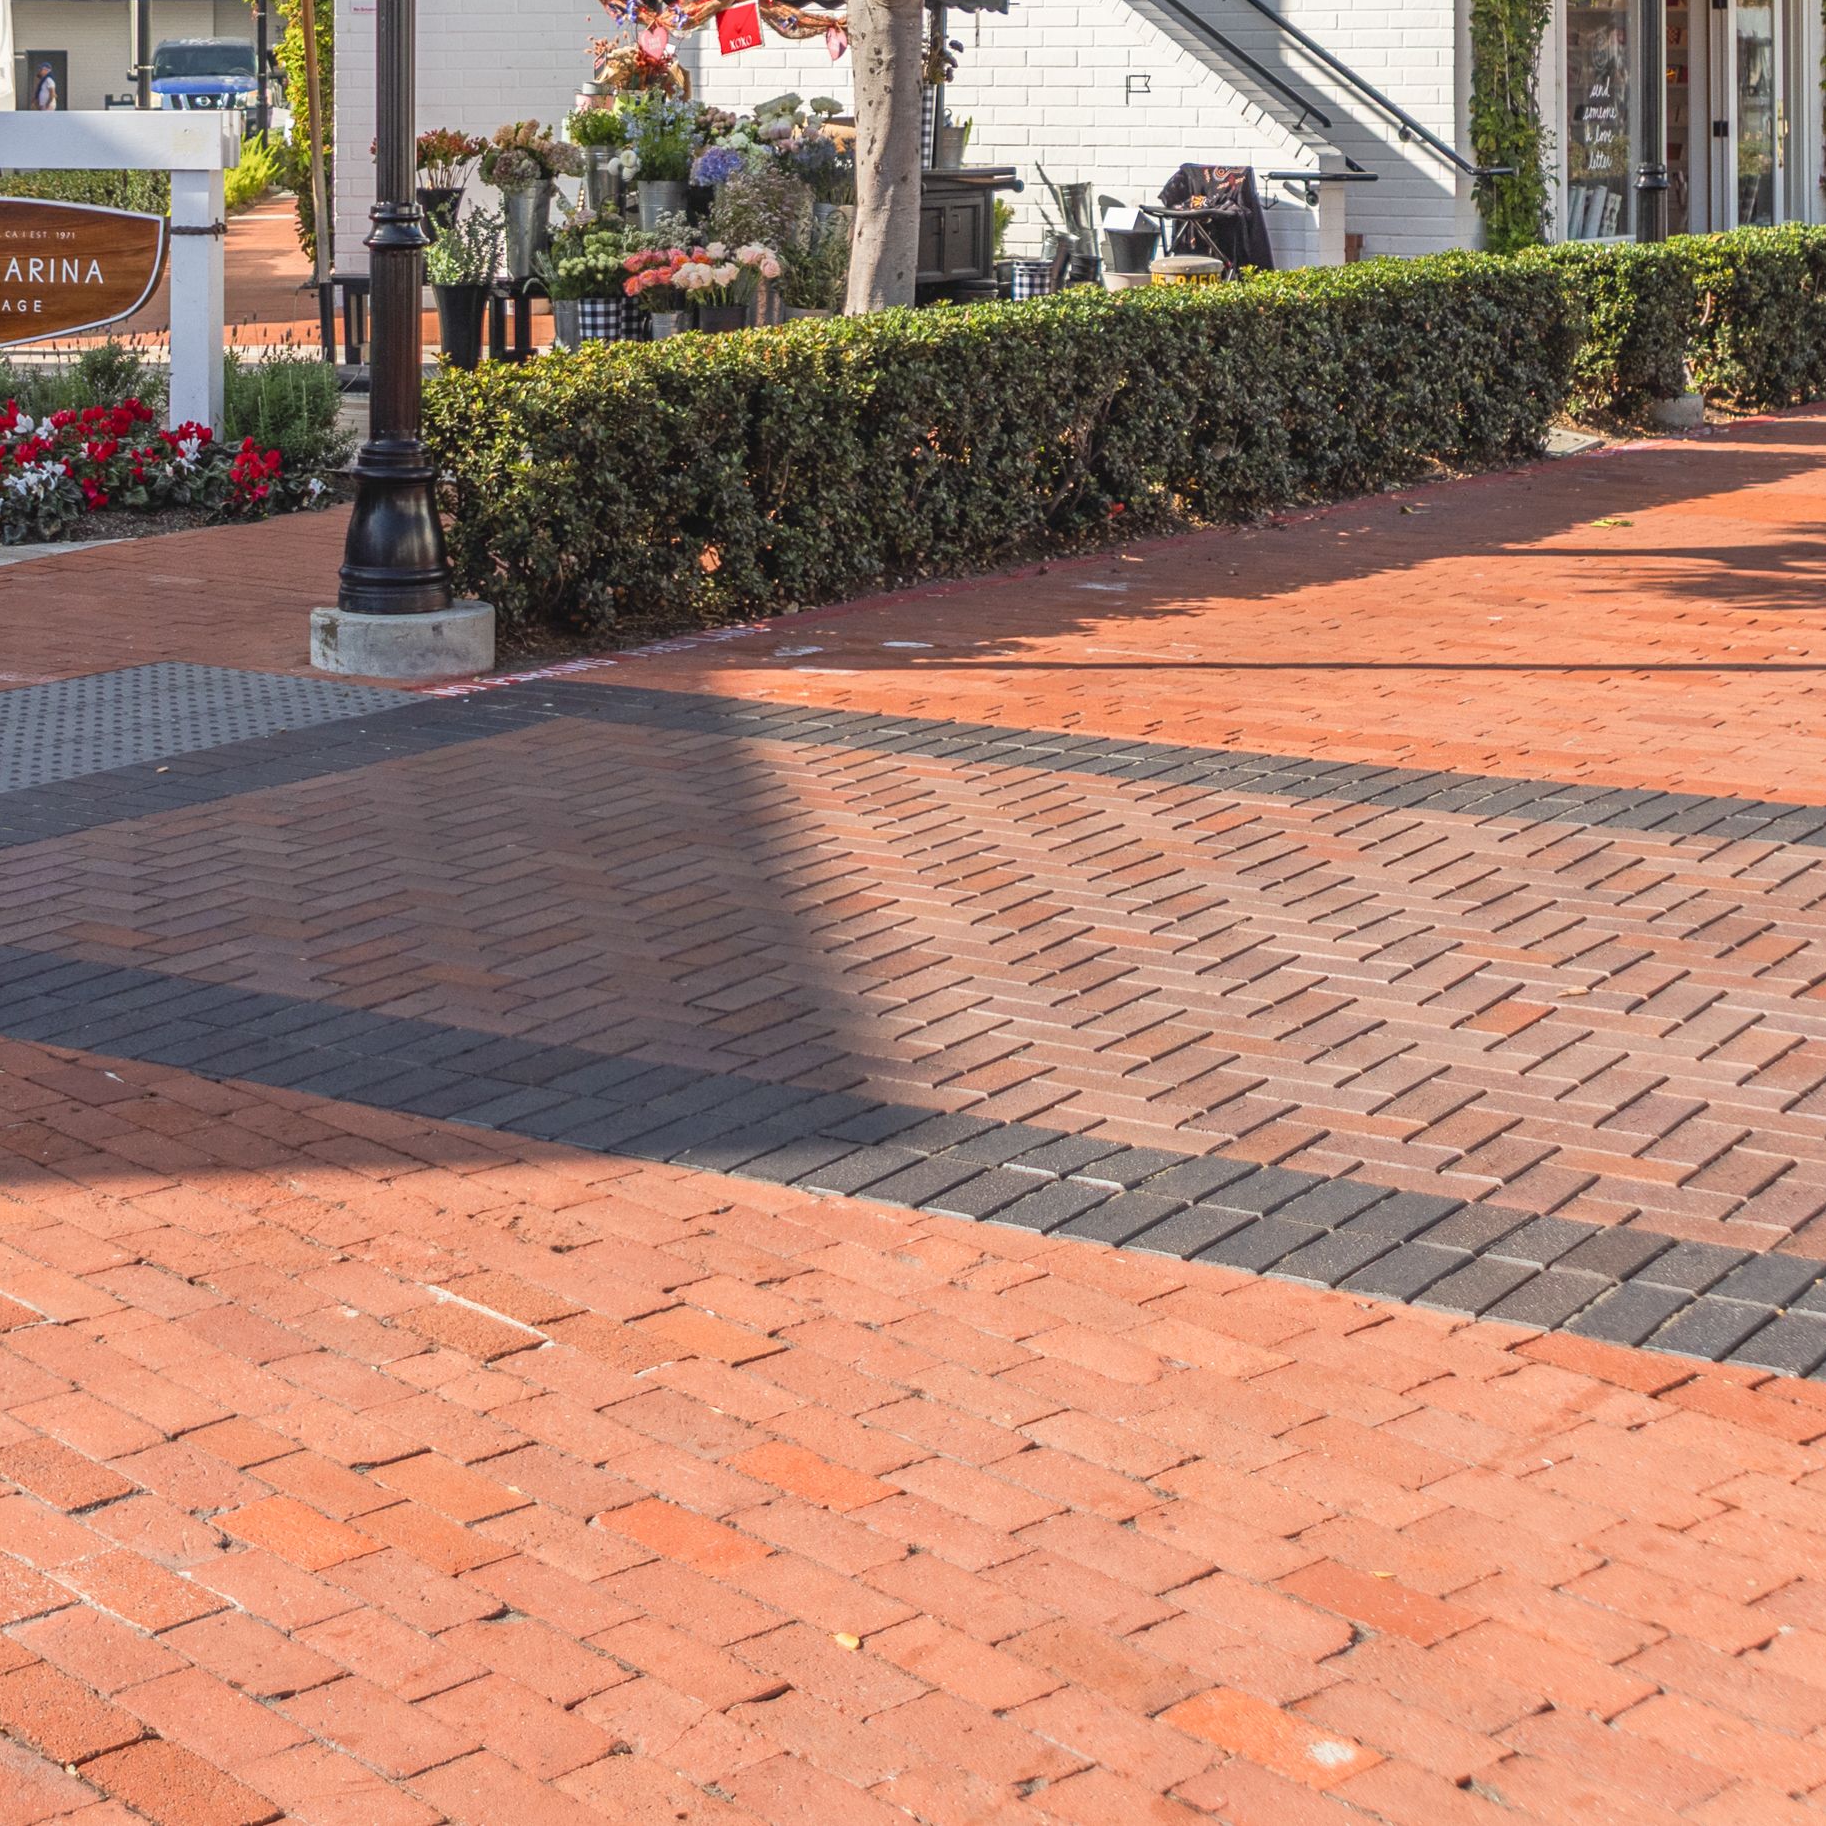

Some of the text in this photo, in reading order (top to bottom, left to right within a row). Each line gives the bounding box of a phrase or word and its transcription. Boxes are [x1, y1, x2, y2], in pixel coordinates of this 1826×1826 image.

[729, 34, 753, 50] XOXO
[1589, 76, 1611, 99] send
[1583, 105, 1617, 121] someone
[1593, 124, 1615, 145] love
[1587, 151, 1613, 170] letter
[5, 230, 19, 239] CA
[30, 230, 51, 239] EST.
[56, 231, 76, 240] 1971
